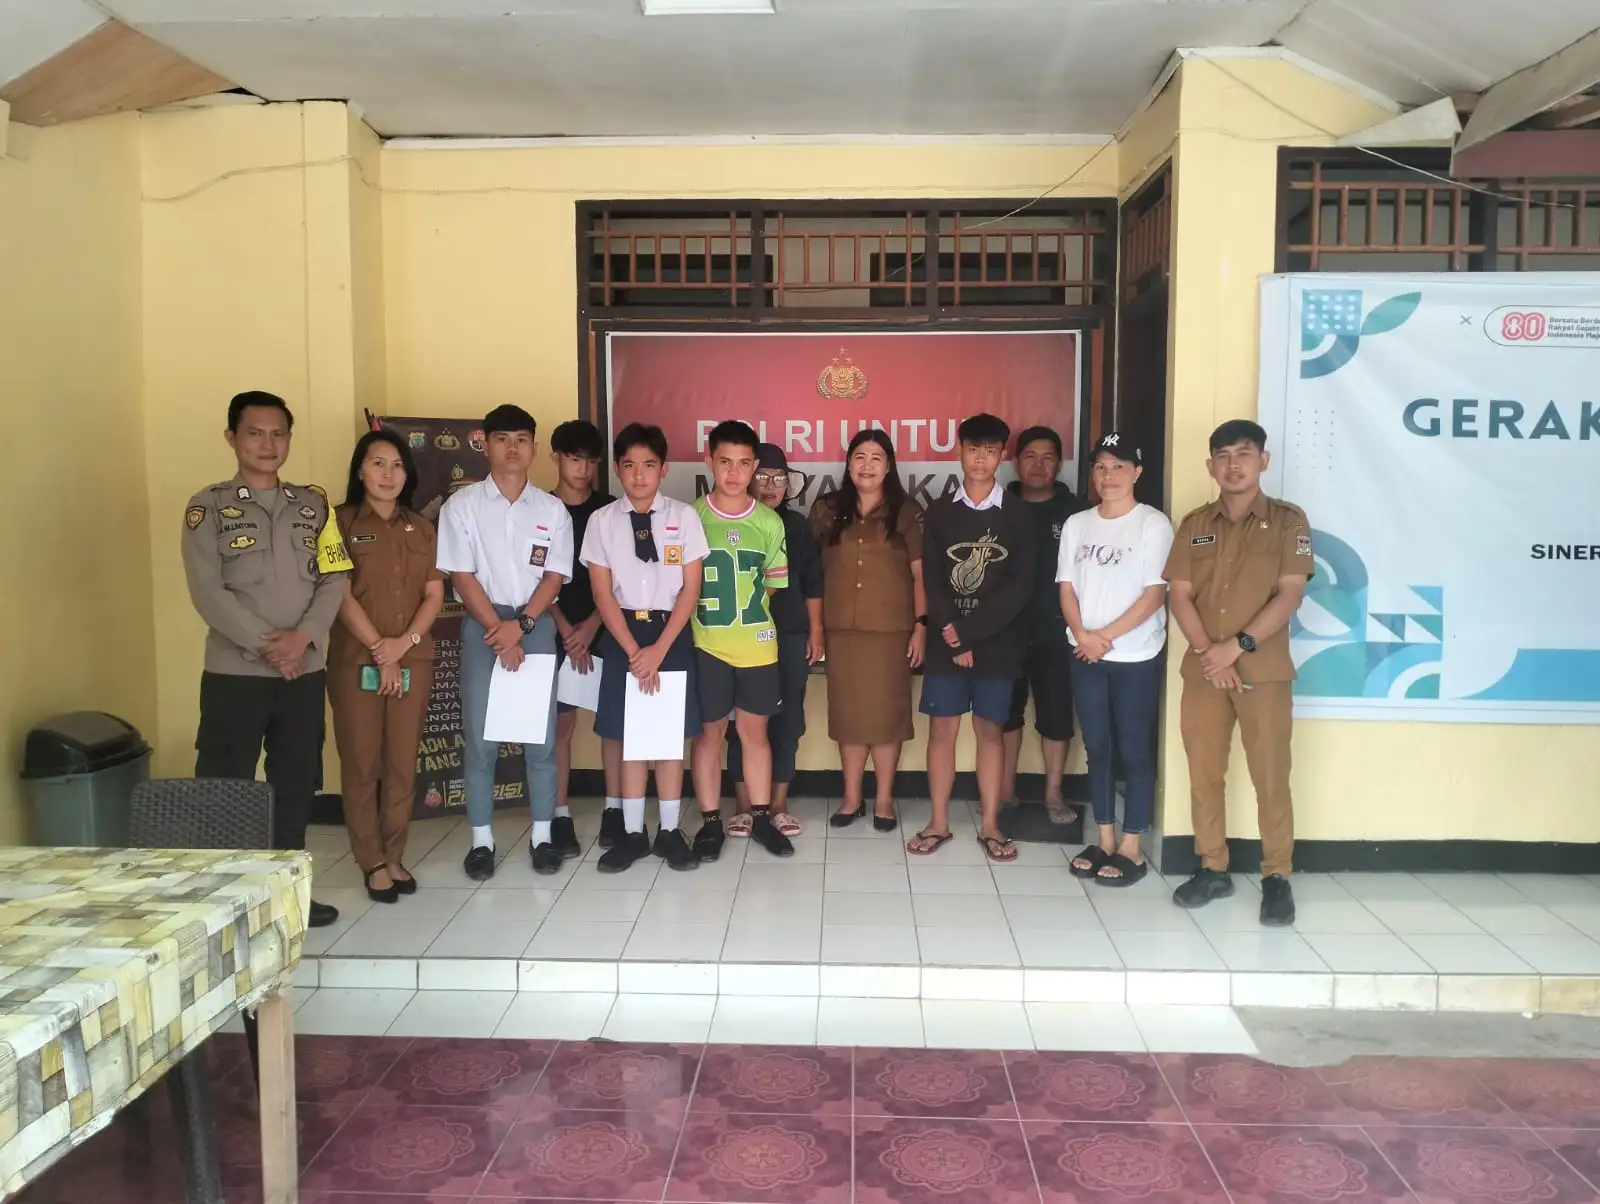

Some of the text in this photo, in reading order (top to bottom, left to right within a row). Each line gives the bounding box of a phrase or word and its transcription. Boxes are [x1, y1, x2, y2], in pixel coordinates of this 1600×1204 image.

[1501, 311, 1545, 341] 80
[696, 418, 966, 453] PLRI UNTU
[694, 547, 770, 628] 97
